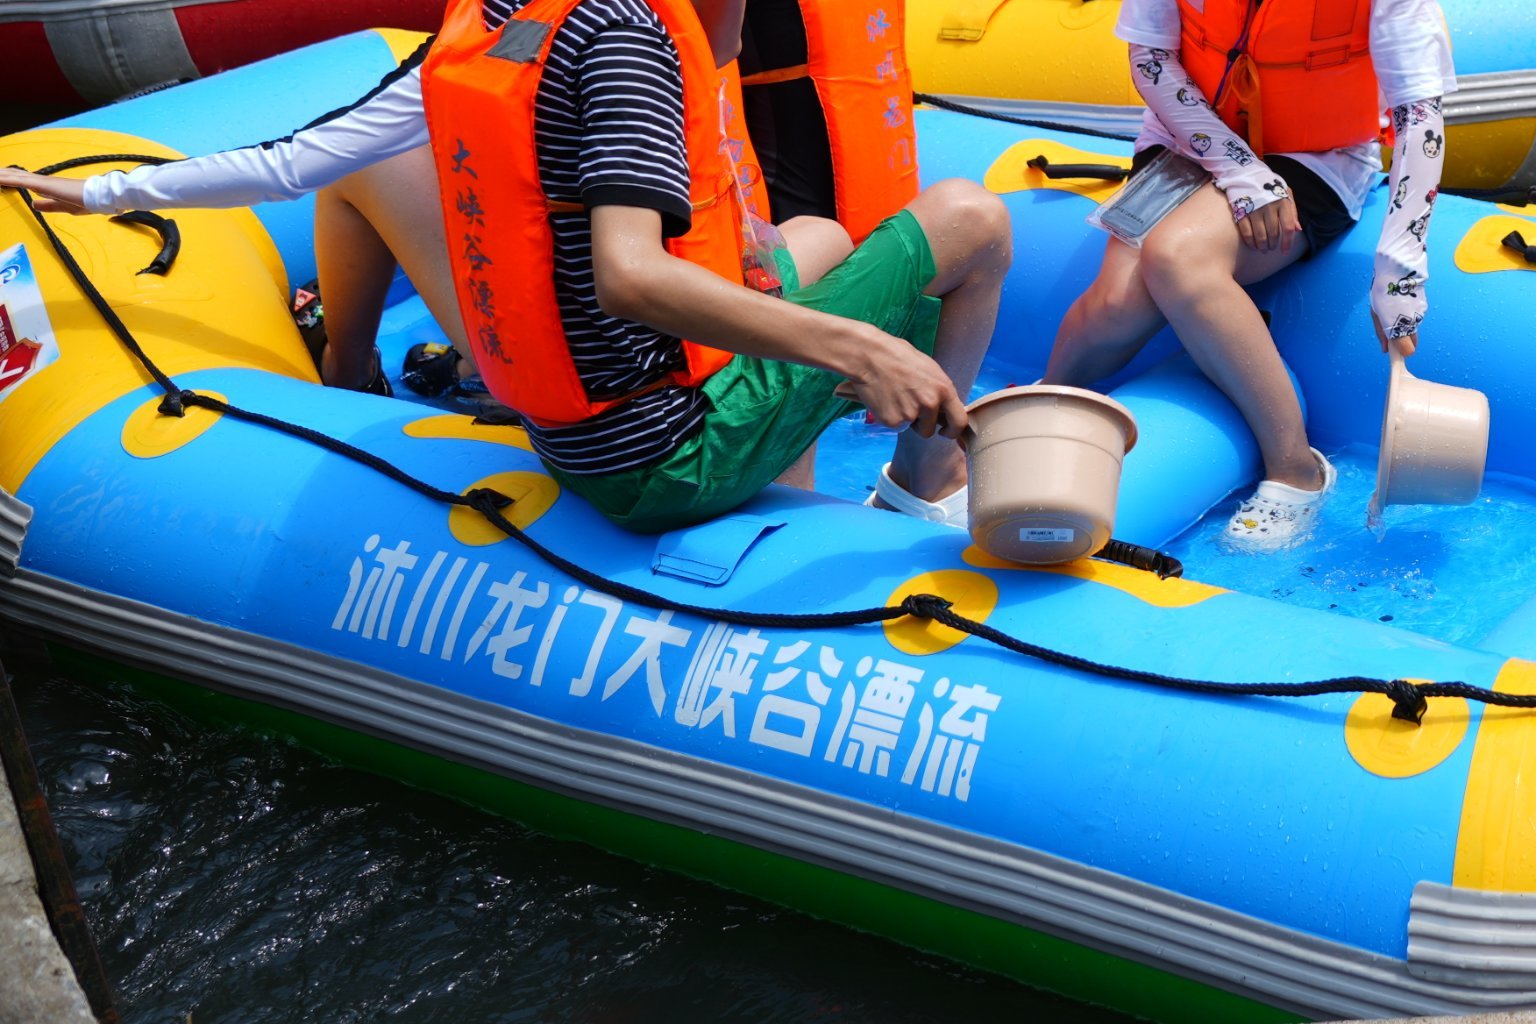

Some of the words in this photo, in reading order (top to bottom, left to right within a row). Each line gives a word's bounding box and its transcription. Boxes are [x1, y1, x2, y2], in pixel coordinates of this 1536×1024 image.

[451, 138, 514, 365] 大峡谷漂流
[329, 532, 1003, 803] 沐川龙门大峡谷漂流
